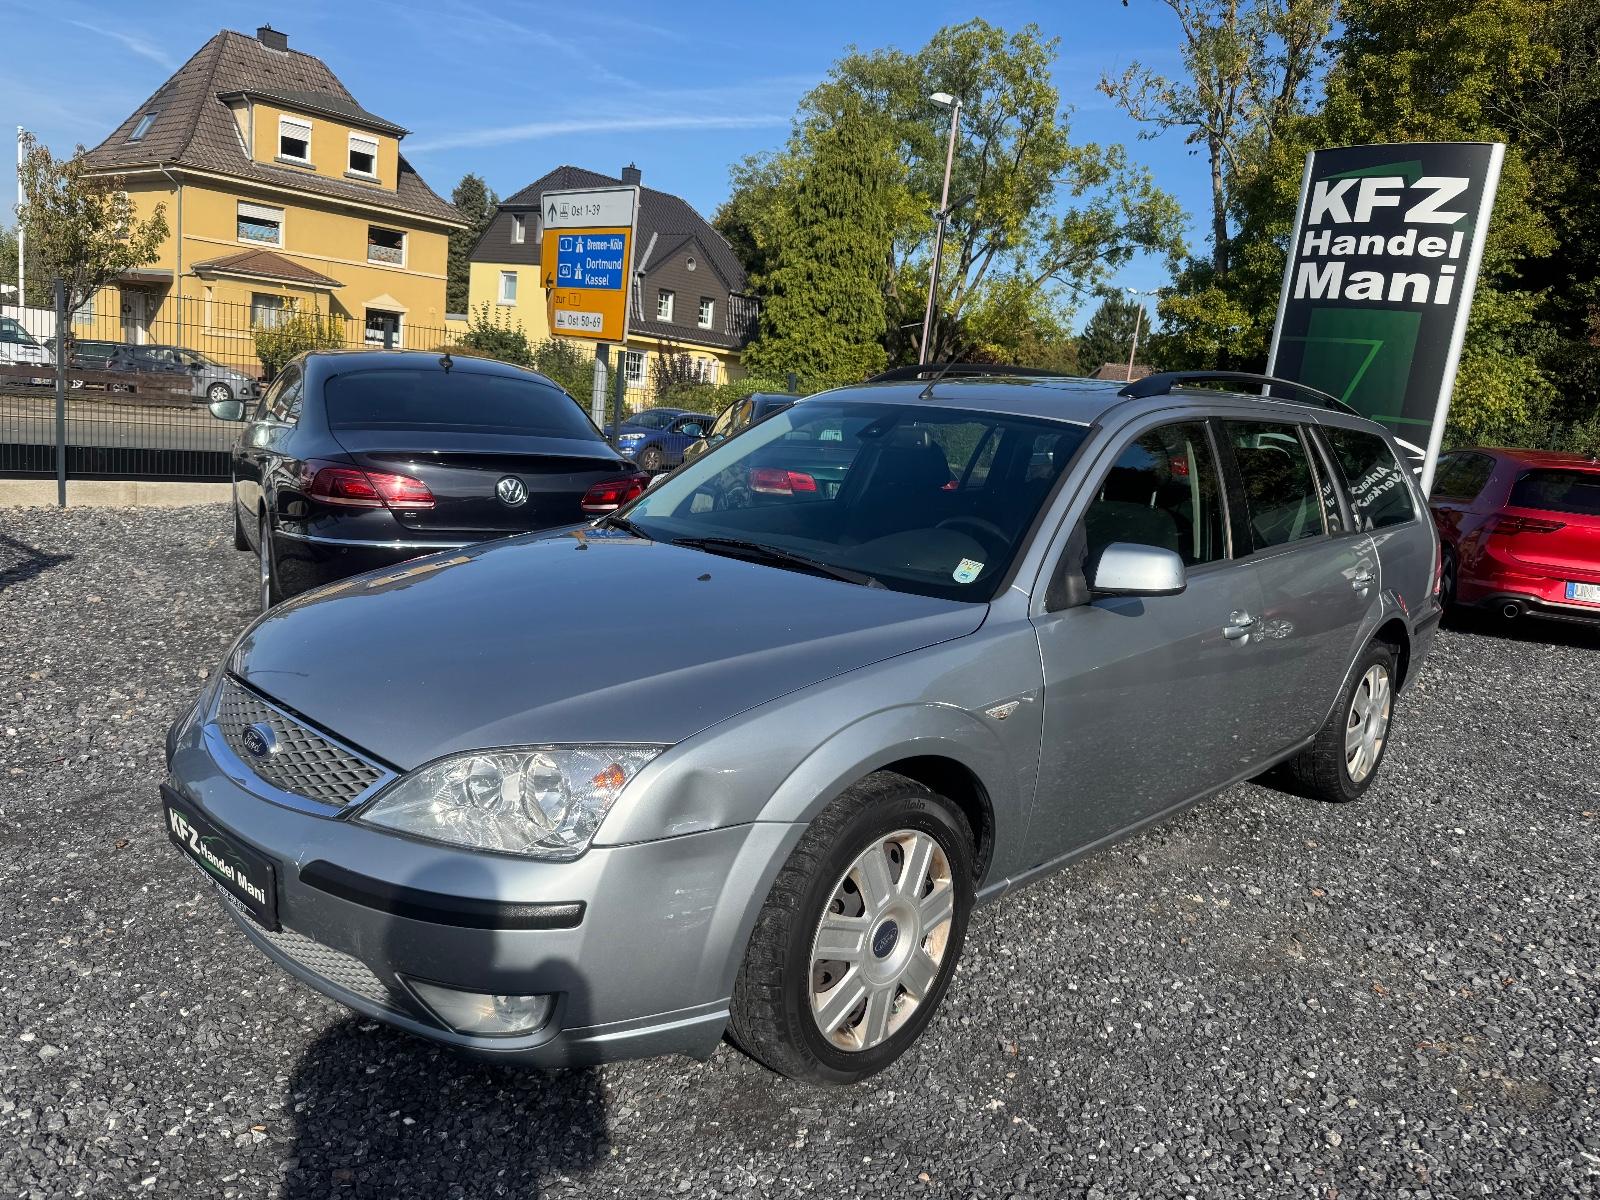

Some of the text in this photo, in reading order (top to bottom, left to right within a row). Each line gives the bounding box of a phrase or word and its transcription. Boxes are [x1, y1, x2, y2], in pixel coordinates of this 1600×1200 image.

[1308, 176, 1470, 225] KFZ
[571, 204, 601, 217] Ost 1-39
[587, 238, 623, 251] Bremen-Köln
[1301, 228, 1465, 259] Handel
[586, 257, 623, 270] Dortmund
[585, 273, 609, 286] Kassel
[1293, 261, 1457, 305] Mani
[555, 296, 567, 304] zur
[567, 314, 601, 328] Ost 50-69
[169, 807, 200, 854] KFZ
[200, 840, 235, 880] Handel
[237, 870, 265, 905] Mani
